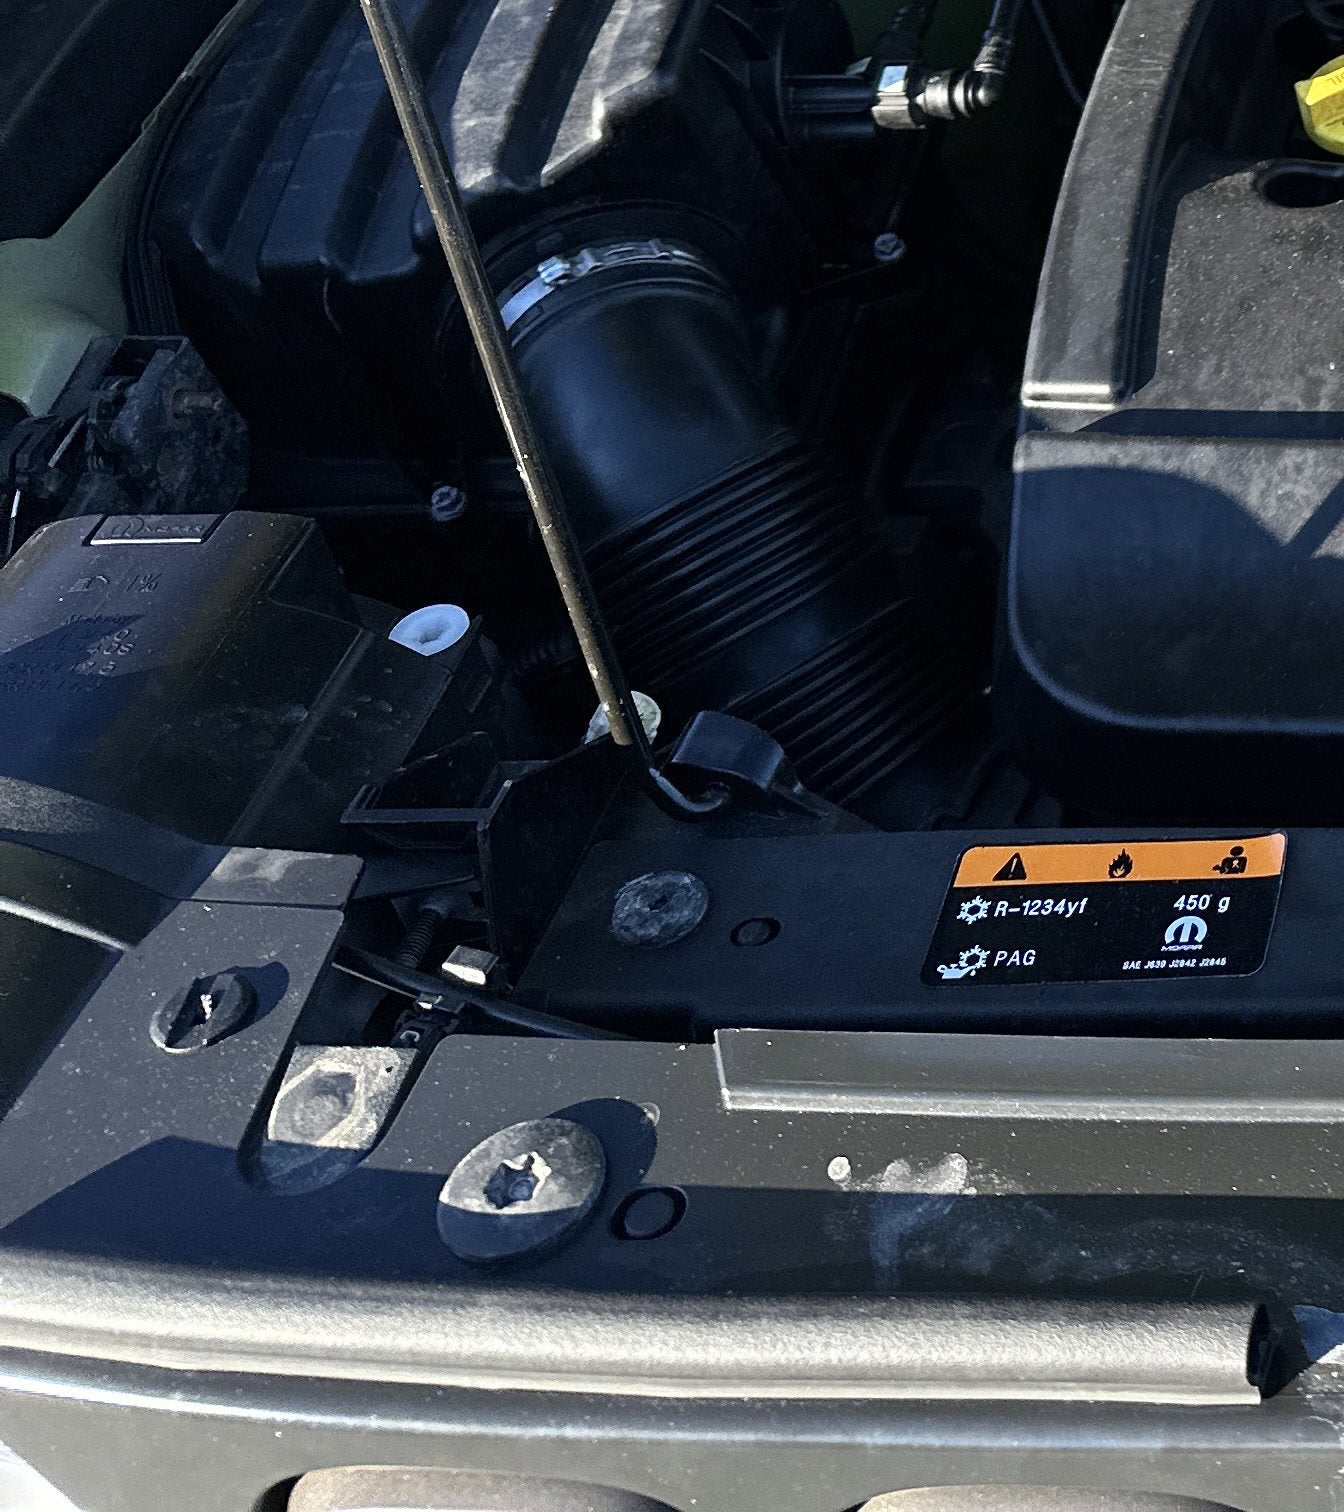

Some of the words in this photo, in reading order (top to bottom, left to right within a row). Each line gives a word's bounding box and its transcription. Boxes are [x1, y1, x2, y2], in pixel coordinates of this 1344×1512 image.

[994, 897, 1089, 918] R-1234yf
[1172, 894, 1212, 911] 450
[1217, 896, 1231, 913] g
[994, 949, 1037, 967] PAG
[1122, 960, 1142, 970] SAE
